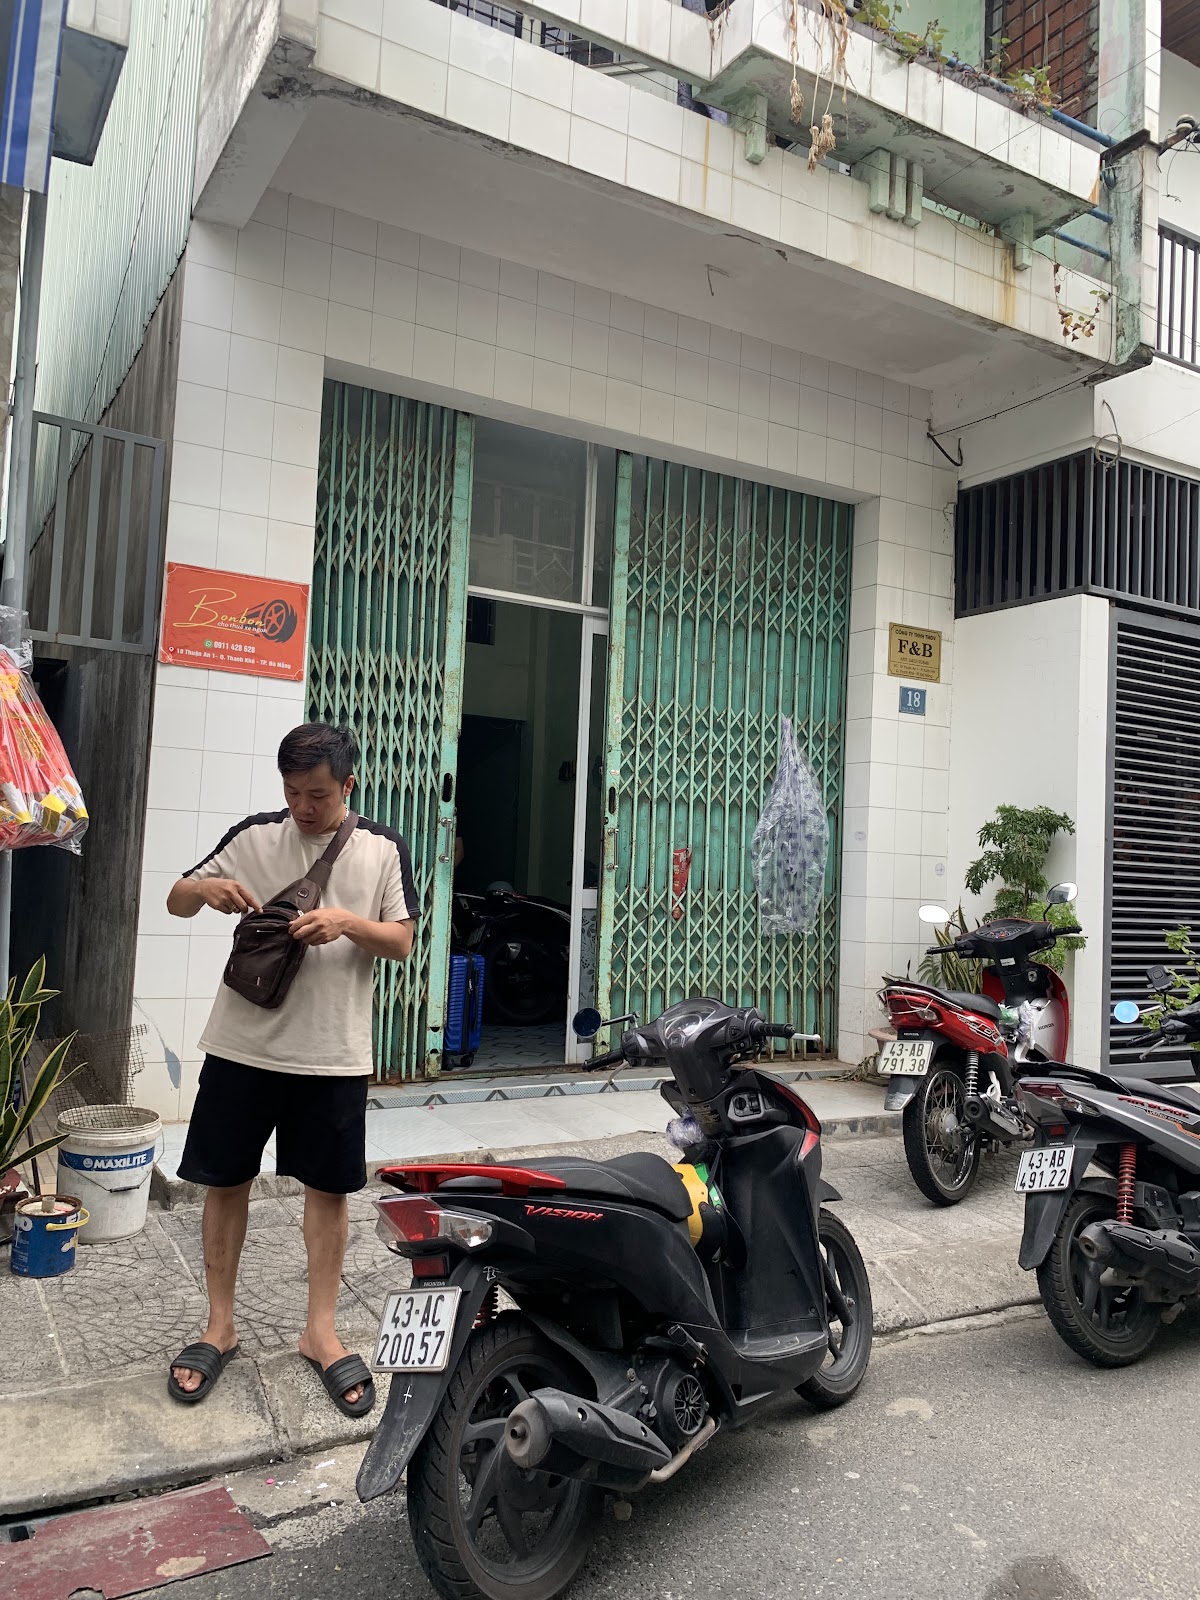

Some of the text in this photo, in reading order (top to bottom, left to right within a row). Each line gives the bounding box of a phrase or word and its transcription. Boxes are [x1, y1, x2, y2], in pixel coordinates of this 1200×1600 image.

[173, 587, 265, 630] Bonbon
[213, 640, 256, 654] 0911 428 628
[897, 638, 933, 658] F&B
[202, 650, 211, 658] An
[227, 655, 243, 663] Thanh
[244, 656, 255, 664] Khê
[907, 690, 920, 708] 18
[1037, 1022, 1055, 1031] HONDA
[889, 1043, 924, 1057] 43-AB
[881, 1057, 926, 1072] 791.38
[93, 1153, 147, 1169] MAXILITE
[1028, 1150, 1066, 1170] 43-AB
[1019, 1168, 1067, 1190] 491.22
[524, 1204, 604, 1222] VISION
[391, 1294, 445, 1329] 43-AC
[376, 1331, 446, 1366] 200.57
